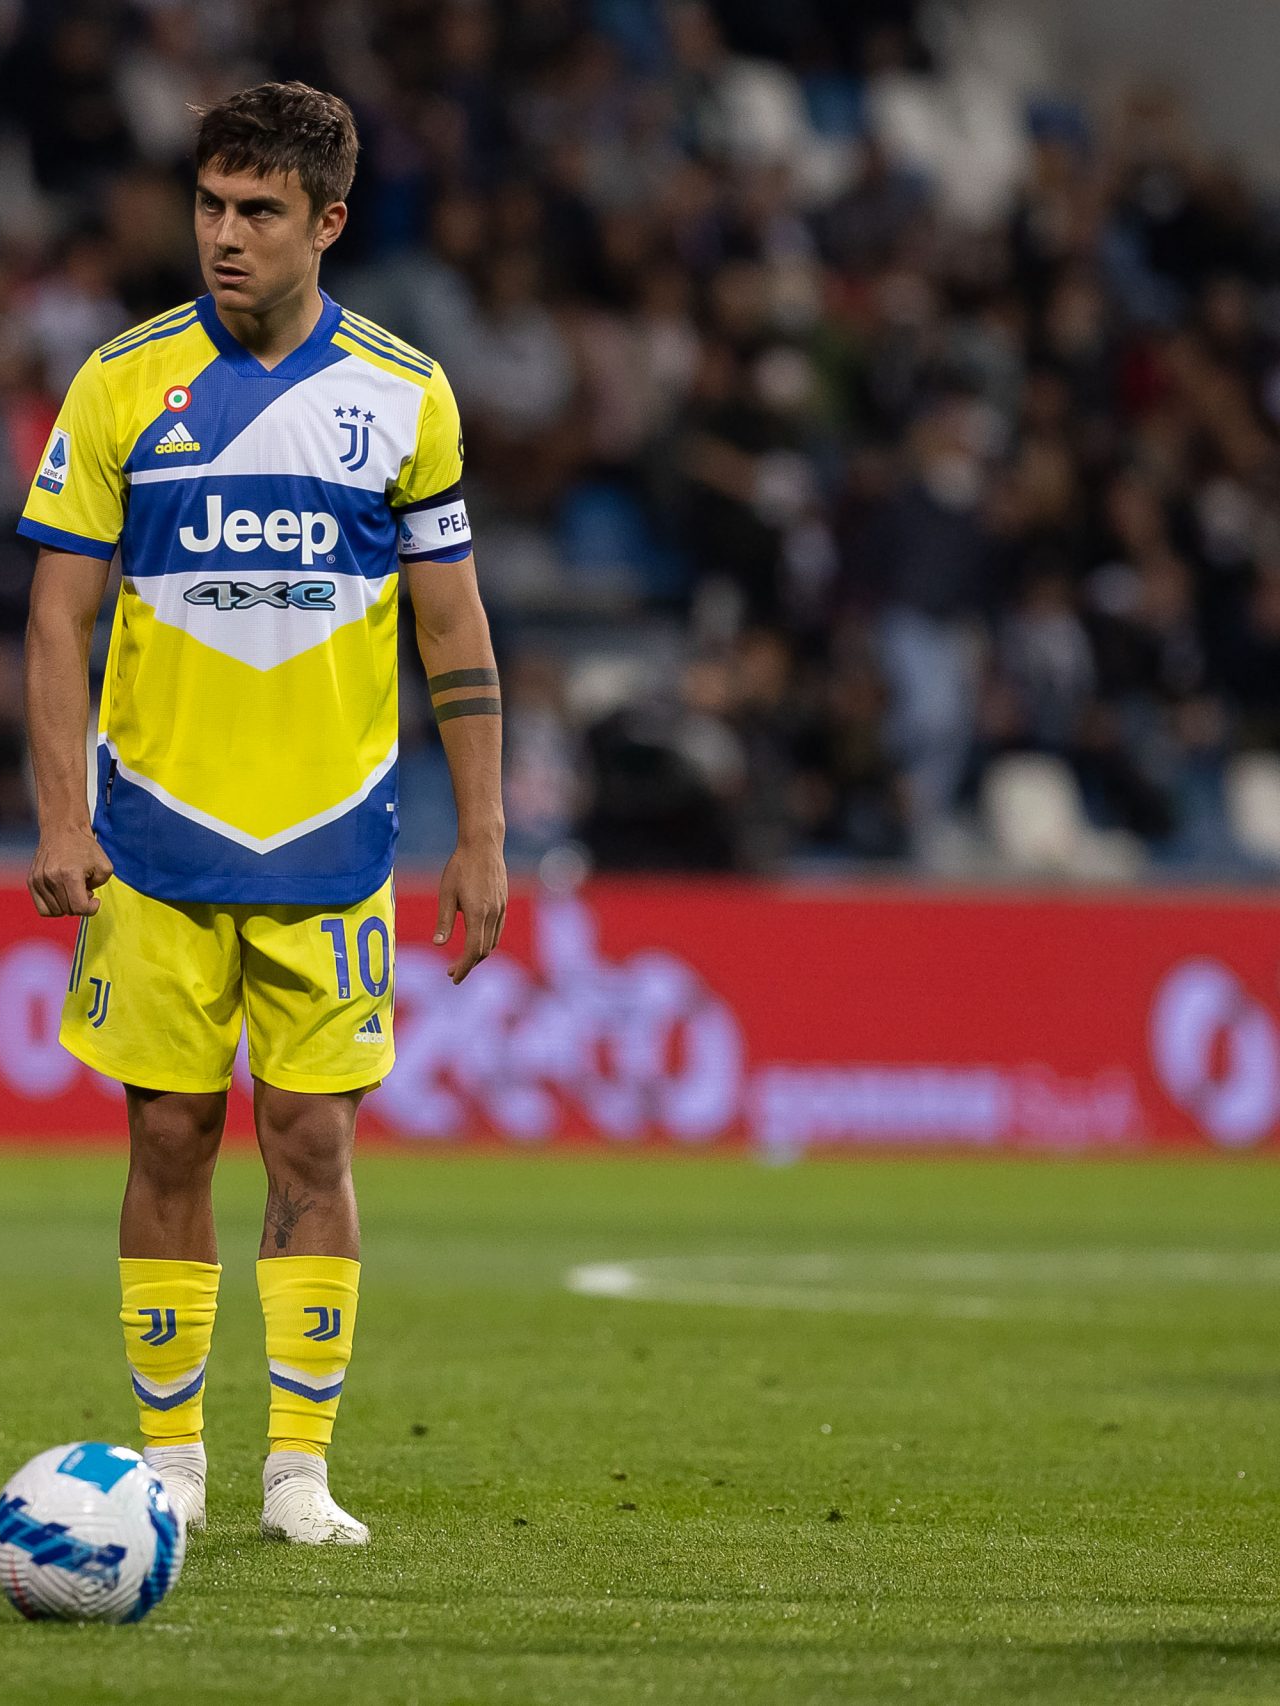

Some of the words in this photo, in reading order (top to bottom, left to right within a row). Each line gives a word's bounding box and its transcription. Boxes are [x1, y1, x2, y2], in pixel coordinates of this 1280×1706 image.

[155, 441, 200, 455] adidas
[179, 495, 339, 565] Jeep
[321, 916, 389, 999] 10
